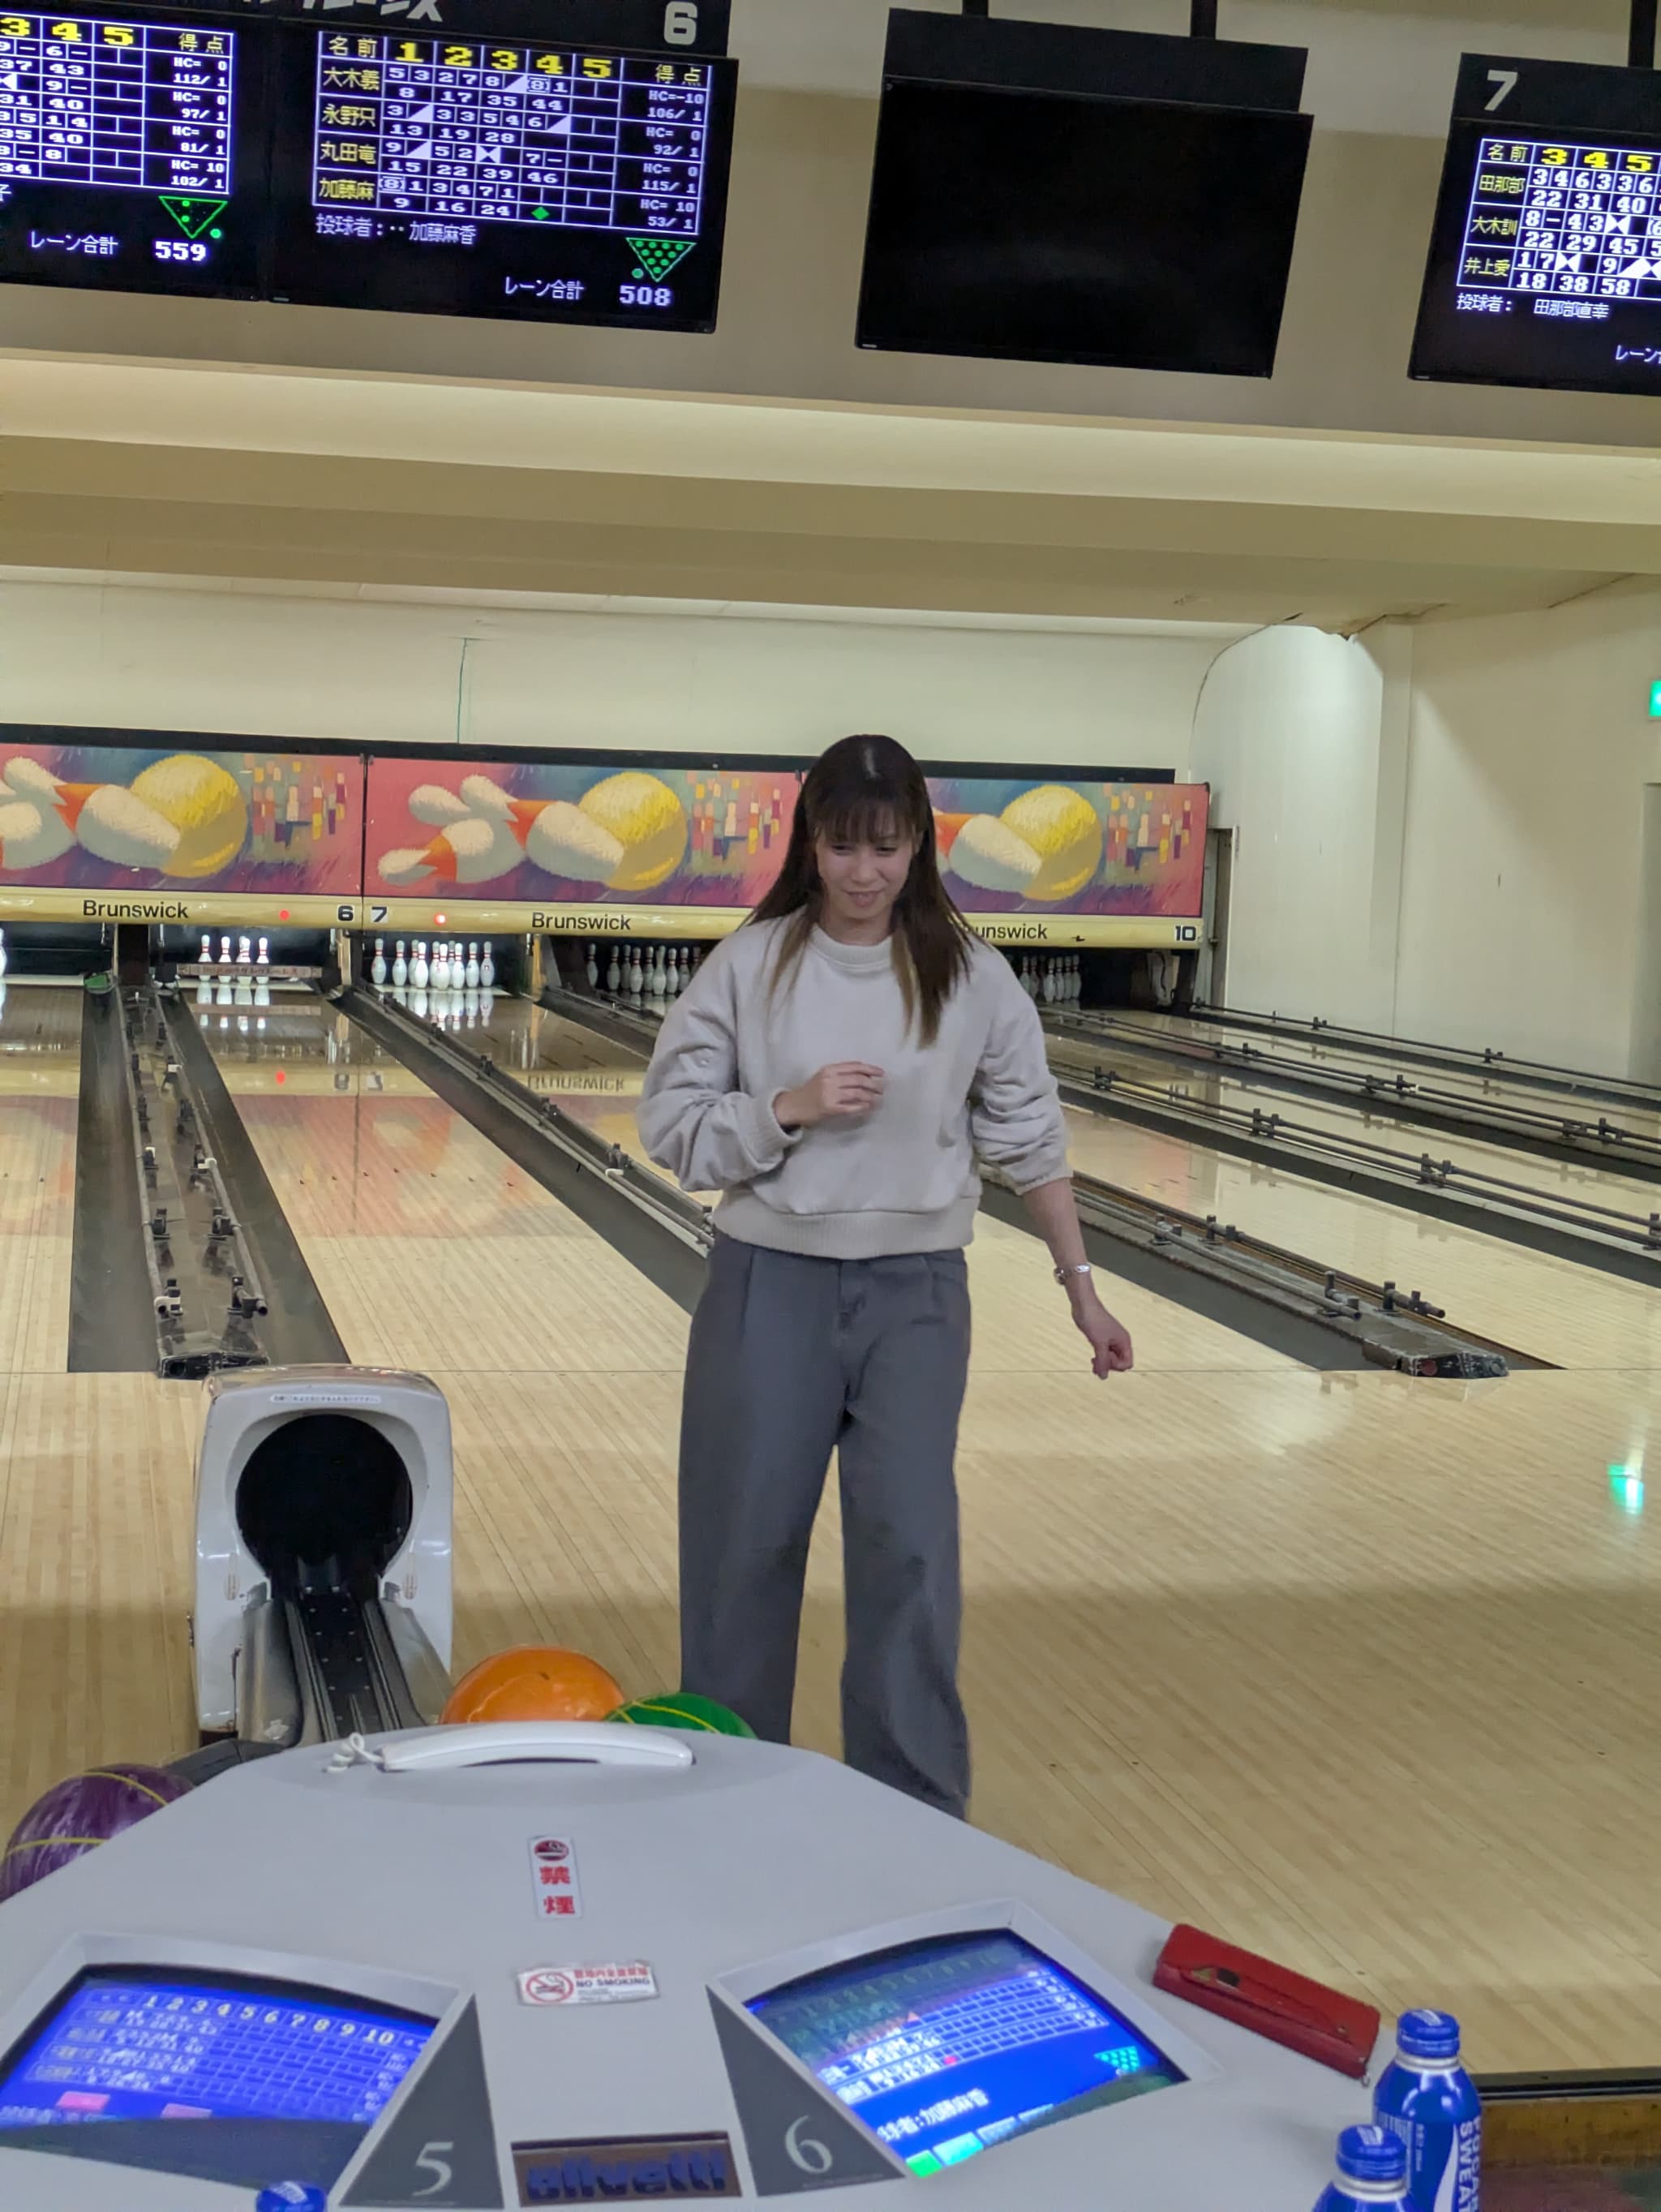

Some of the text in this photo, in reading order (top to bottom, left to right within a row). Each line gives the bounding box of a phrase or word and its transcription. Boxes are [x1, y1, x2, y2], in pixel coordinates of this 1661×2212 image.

[1, 18, 30, 36] 3
[52, 23, 81, 41] 4
[104, 27, 133, 45] 5
[663, 2, 697, 45] 6
[46, 46, 227, 71] 6 HC= 0
[49, 64, 84, 75] 43
[396, 42, 423, 62] 1
[444, 46, 473, 67] 2
[491, 49, 518, 70] 3
[537, 54, 564, 74] 4
[583, 58, 612, 77] 5
[389, 67, 405, 78] 5
[414, 71, 430, 80] 3
[439, 72, 453, 82] 2
[462, 74, 477, 84] 7
[486, 76, 500, 86] 8
[553, 82, 568, 92] 1
[1485, 70, 1517, 111] 7
[46, 81, 226, 105] 9 HC= 0
[49, 99, 84, 110] 40
[398, 88, 414, 97] 8
[440, 92, 472, 102] 17
[487, 95, 517, 106] 35
[532, 99, 563, 110] 44
[19, 113, 225, 139] 5 1 4 HC= 0
[387, 105, 403, 115] 3
[436, 110, 452, 119] 3
[460, 111, 475, 121] 3
[483, 114, 498, 123] 5
[505, 115, 520, 125] 4
[528, 117, 543, 127] 6
[646, 127, 674, 138] HC=
[690, 131, 701, 140] 0
[389, 124, 423, 135] 13
[439, 128, 470, 140] 19
[485, 132, 515, 143] 28
[49, 133, 83, 144] 40
[45, 149, 225, 173] 8 HC= 10
[320, 141, 697, 177] 丸田竜 9 5 2 7 HC= 0
[1541, 148, 1567, 165] 3
[1584, 152, 1608, 169] 4
[1626, 155, 1652, 172] 5
[388, 161, 421, 173] 15
[436, 165, 468, 176] 22
[483, 169, 513, 180] 39
[527, 172, 558, 183] 46
[686, 183, 696, 193] 1
[1533, 169, 1547, 185] 3
[1555, 170, 1568, 187] 4
[1575, 172, 1589, 188] 6
[1596, 174, 1611, 190] 3
[1618, 175, 1633, 191] 3
[1638, 178, 1653, 193] 6
[409, 181, 423, 191] 1
[433, 183, 448, 193] 3
[457, 185, 470, 195] 4
[480, 187, 493, 196] 7
[501, 188, 515, 199] 1
[641, 199, 668, 209] HC=
[676, 202, 695, 212] 10
[1531, 190, 1646, 213] 22 31 40
[394, 198, 410, 208] 9
[435, 201, 466, 213] 16
[481, 204, 510, 216] 24
[684, 219, 693, 229] 1
[1526, 210, 1540, 226] 8
[1568, 214, 1581, 230] 4
[1589, 216, 1603, 231] 3
[31, 230, 207, 261] レーン合計 559
[1524, 231, 1638, 255] 22 29 45
[1464, 252, 1616, 277] 井上愛 1 7 9
[505, 276, 672, 307] レーン合計 508
[1516, 273, 1630, 295] 18 38 58
[84, 900, 188, 918] Brunswick
[337, 905, 353, 921] 6
[371, 906, 387, 922] 7
[532, 912, 631, 930] Brunswick
[976, 923, 1047, 939] unswick
[1175, 926, 1196, 941] 10
[597, 1978, 650, 1987] SMOKING
[144, 1995, 157, 2008] 1
[166, 1997, 184, 2011] 2
[191, 1999, 208, 2013] 3
[217, 2003, 231, 2017] 4
[240, 2005, 257, 2020] 5
[264, 2010, 280, 2024] 6
[292, 2013, 306, 2027] 7
[313, 2018, 331, 2033] 8
[340, 2023, 356, 2037] 9
[364, 2029, 394, 2045] 10
[785, 2115, 832, 2173] 6
[412, 2141, 453, 2196] 5
